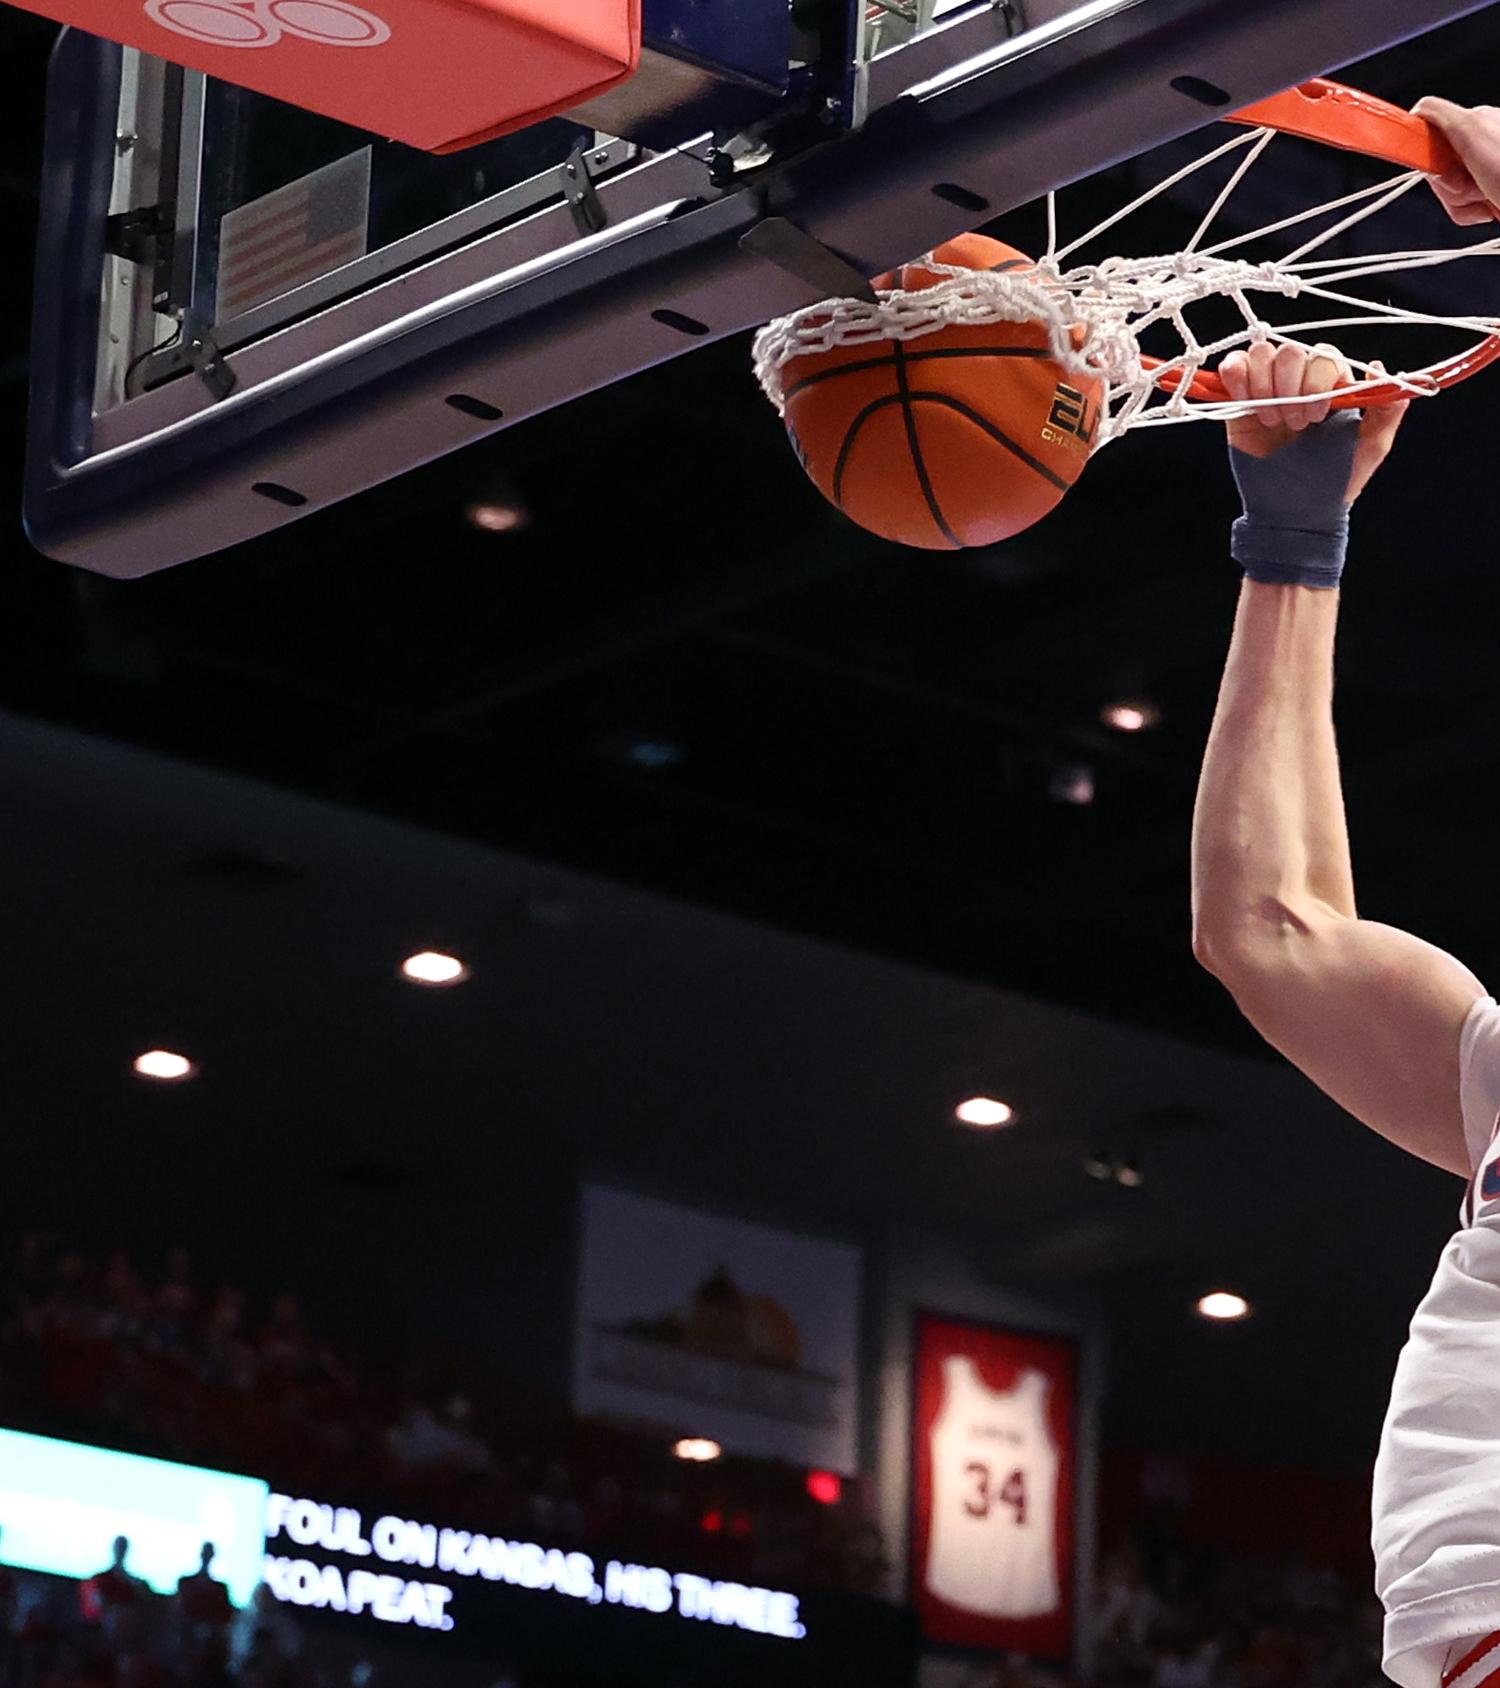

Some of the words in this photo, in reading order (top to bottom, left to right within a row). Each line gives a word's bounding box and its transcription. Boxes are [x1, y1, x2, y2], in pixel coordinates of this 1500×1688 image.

[964, 1462, 1026, 1525] 34
[266, 1493, 372, 1556] FOUL
[372, 1515, 437, 1568] ON
[436, 1527, 603, 1604] KANSAS,
[604, 1560, 673, 1613] HIS
[673, 1573, 806, 1639] THREE.
[347, 1569, 455, 1631] PEAT.
